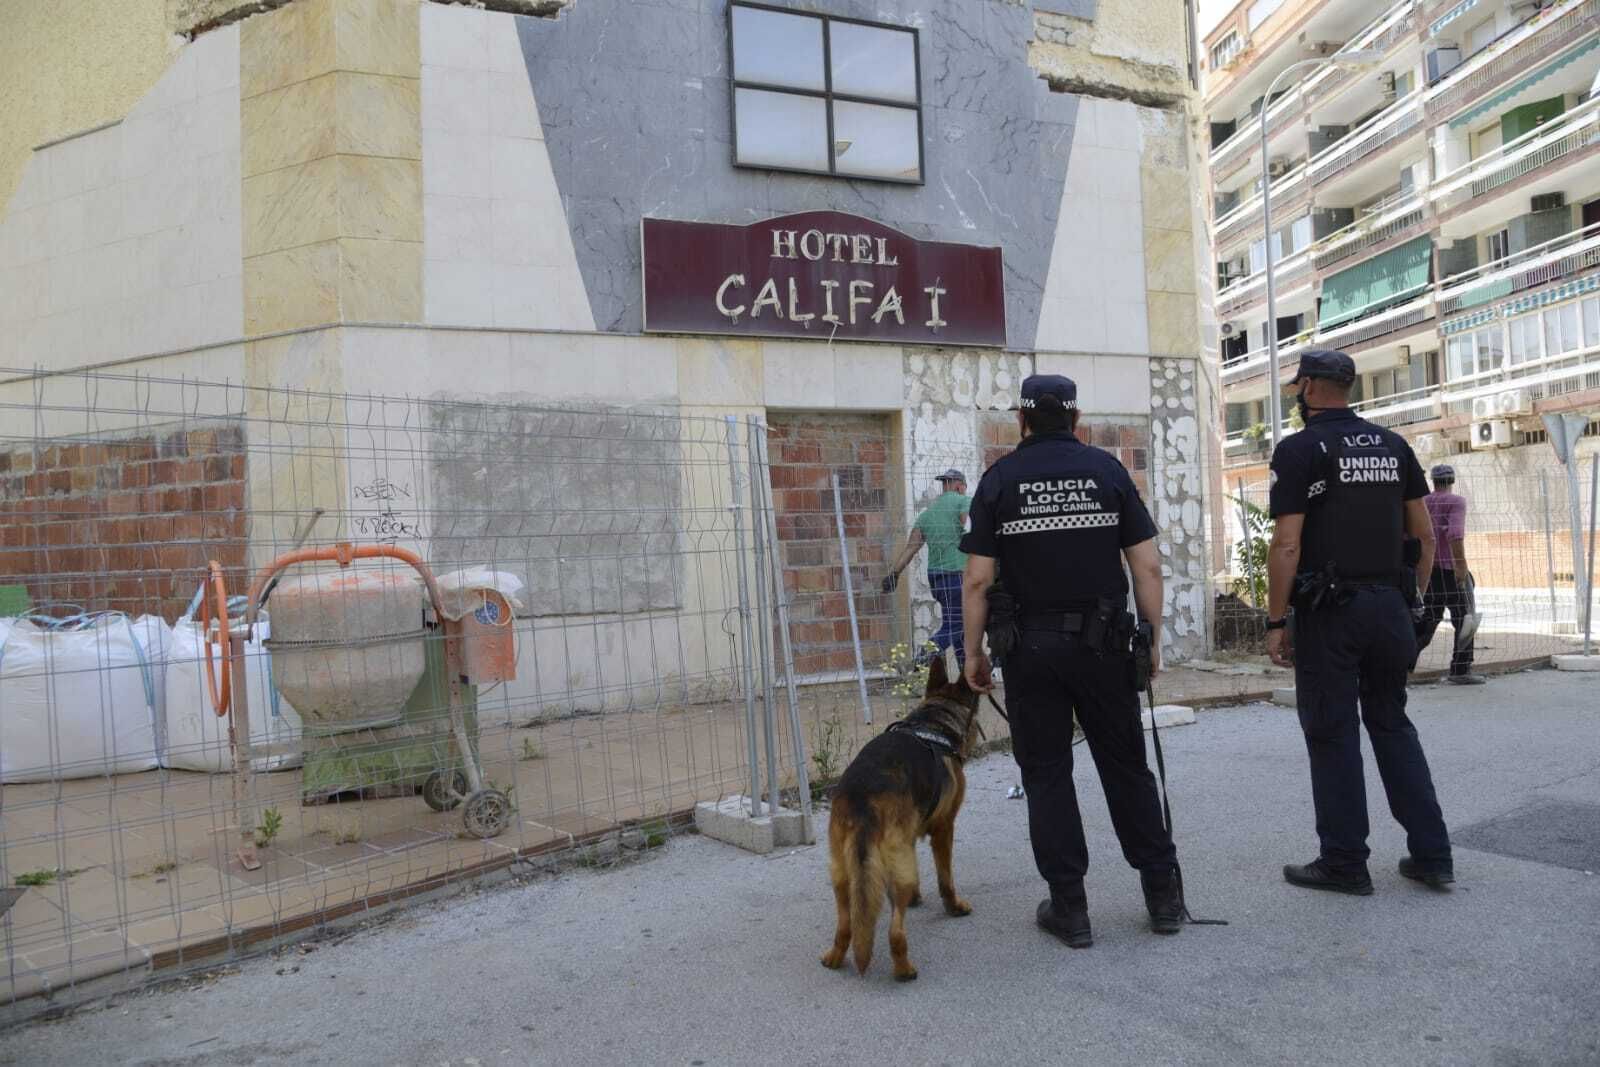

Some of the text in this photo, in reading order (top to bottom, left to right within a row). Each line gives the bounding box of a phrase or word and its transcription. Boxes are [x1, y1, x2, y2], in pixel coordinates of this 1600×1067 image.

[770, 229, 898, 266] HOTEL
[716, 274, 947, 328] CALIFA I
[1339, 456, 1398, 469] UNIDAD
[1339, 469, 1400, 482] CANINA
[1019, 479, 1098, 494] POLICIA
[1027, 491, 1092, 505] LOCAL
[1020, 501, 1102, 515] UNIDAD CANINA
